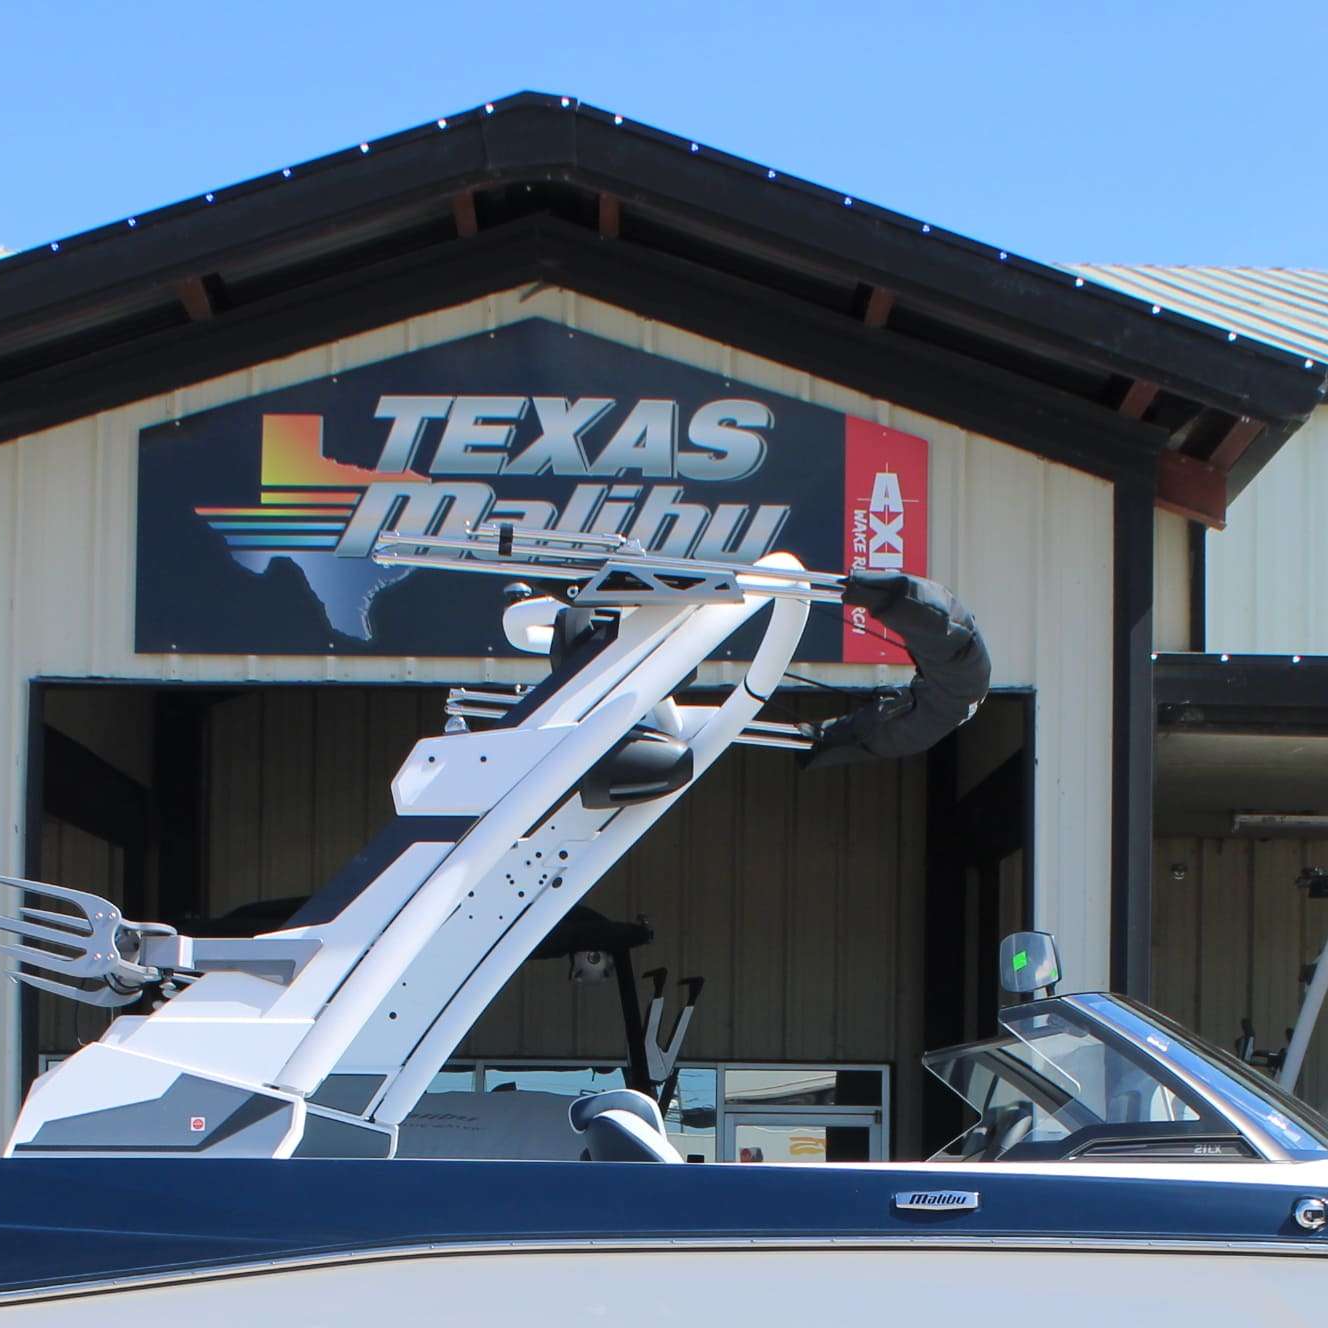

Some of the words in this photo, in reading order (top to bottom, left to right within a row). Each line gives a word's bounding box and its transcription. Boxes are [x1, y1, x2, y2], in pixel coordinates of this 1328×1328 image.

[372, 395, 775, 481] TEXAS
[852, 510, 867, 553] WAKE
[869, 473, 904, 571] AXI
[909, 1193, 967, 1205] Malibu
